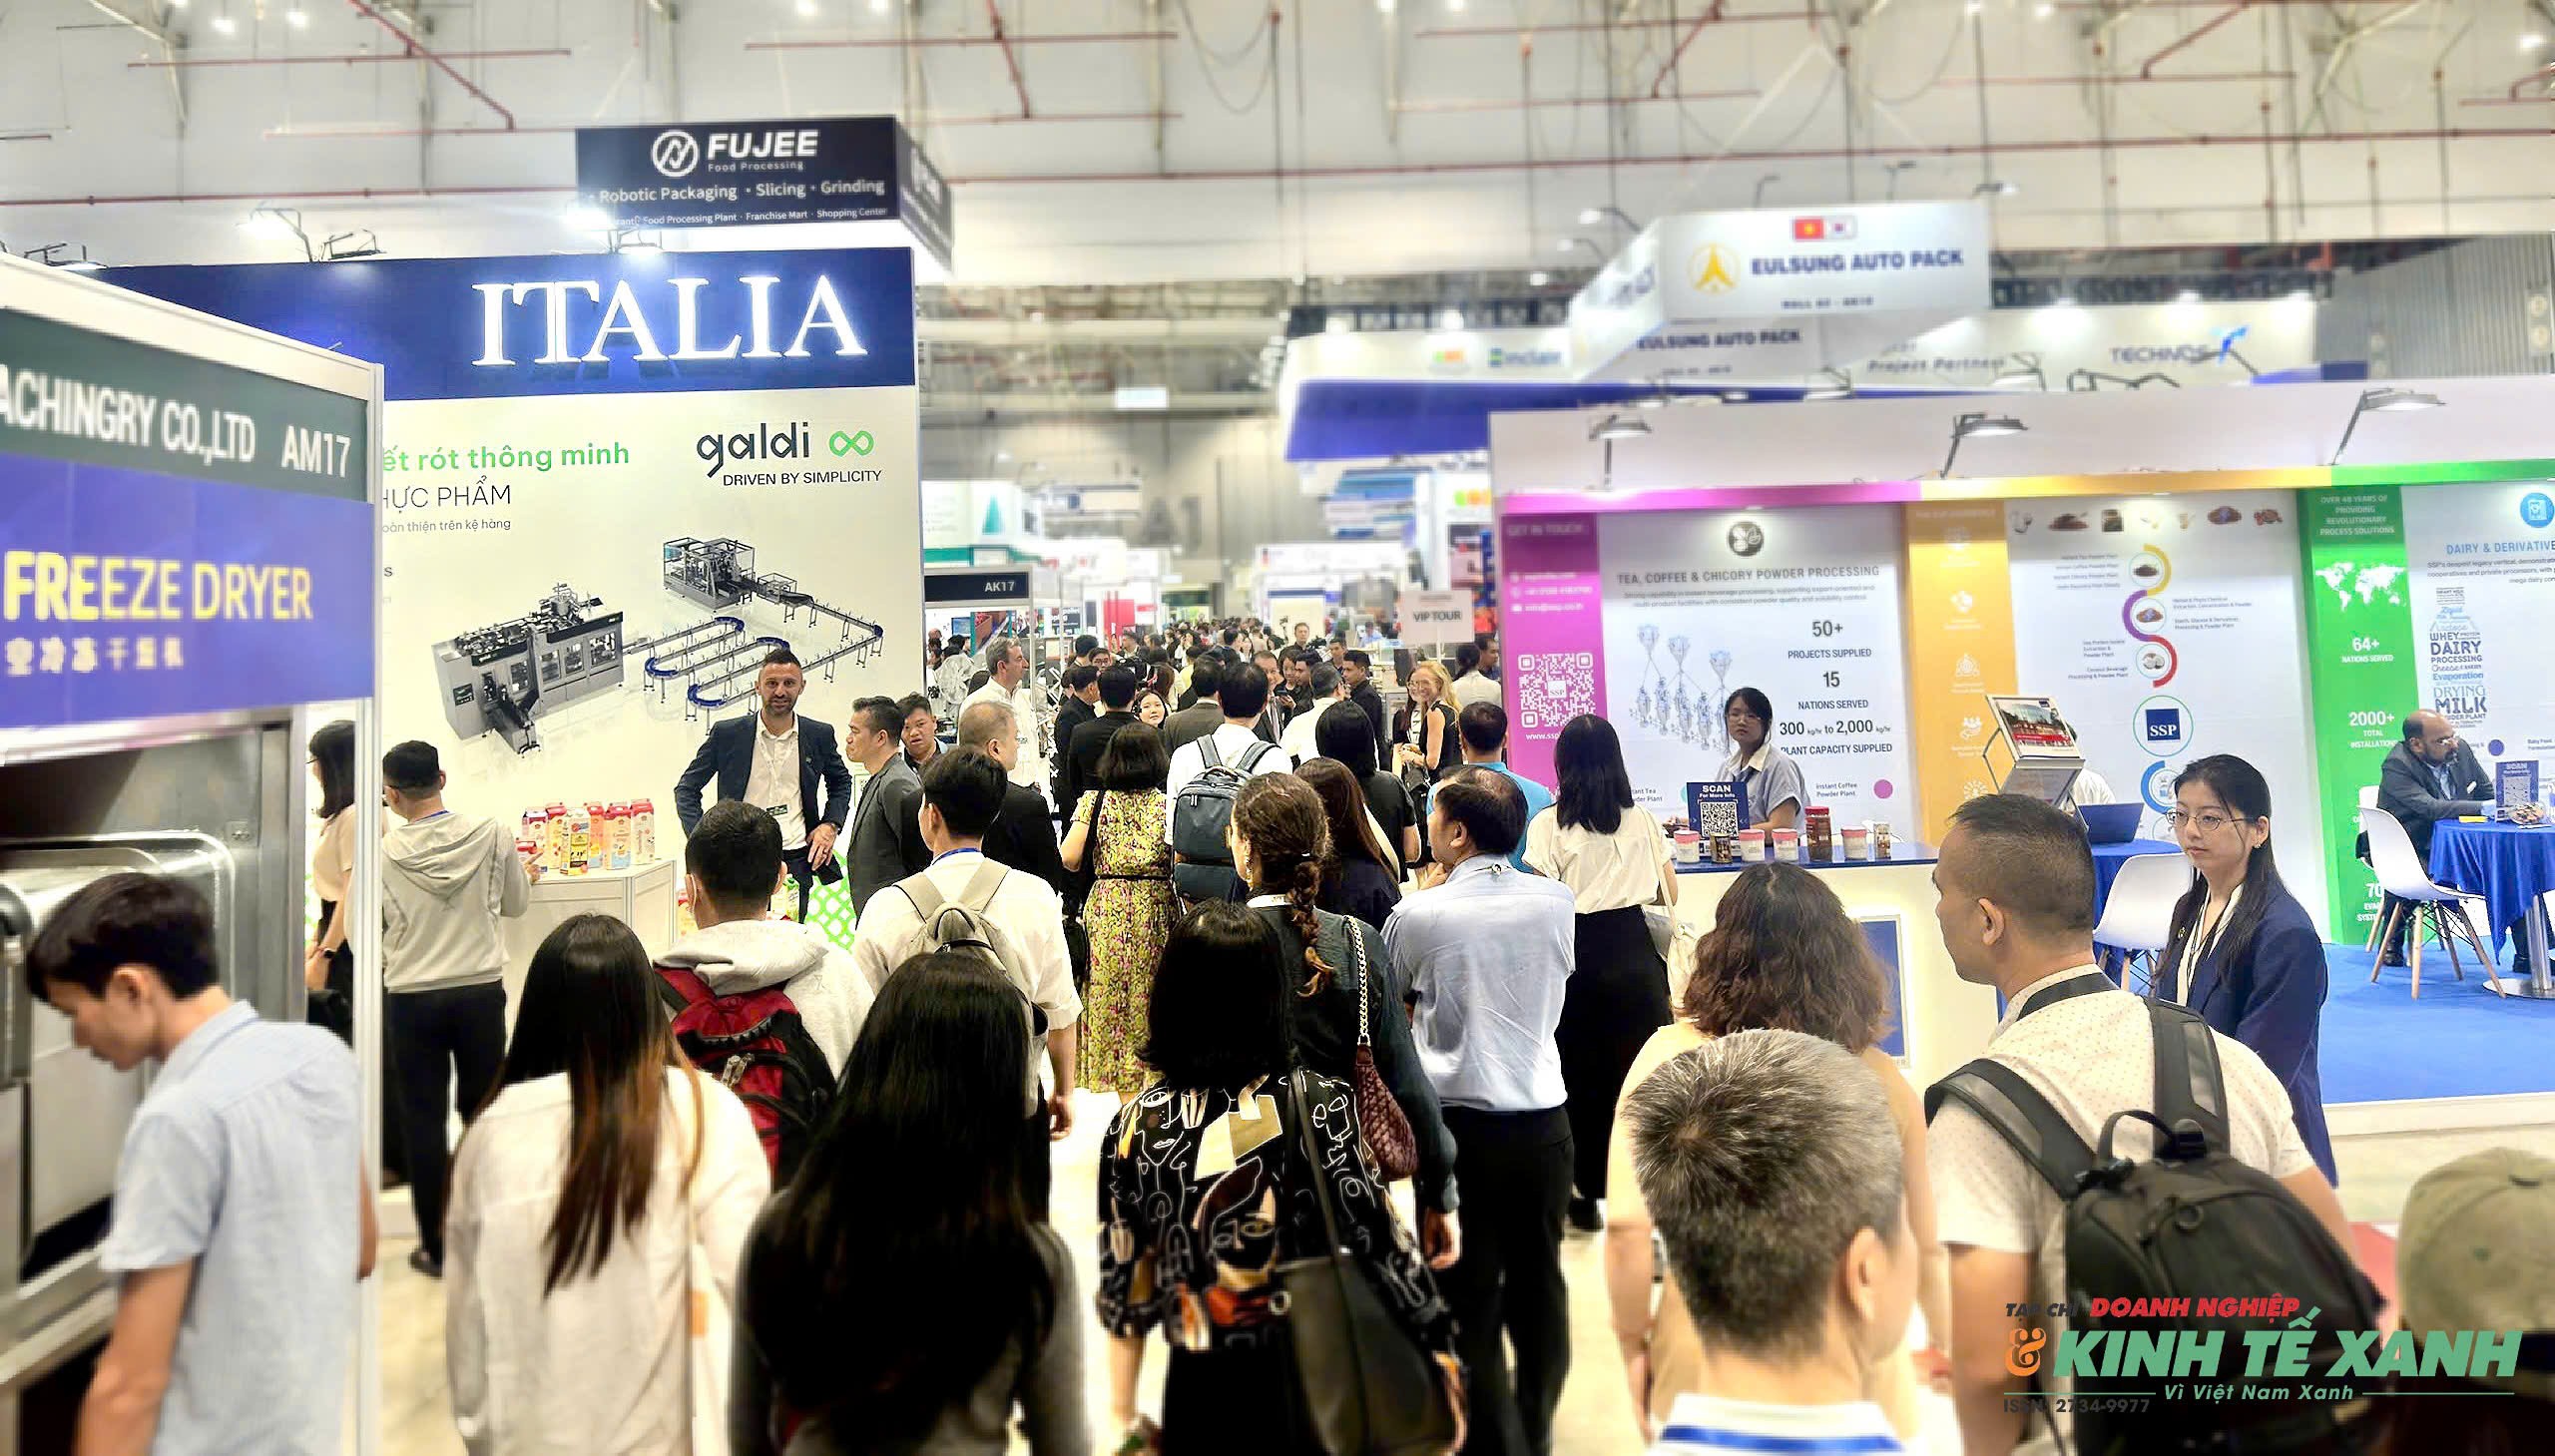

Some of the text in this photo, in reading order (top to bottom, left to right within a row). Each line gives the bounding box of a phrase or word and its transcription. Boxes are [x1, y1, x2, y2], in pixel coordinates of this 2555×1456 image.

[707, 129, 819, 161] FUJEE
[708, 160, 804, 173] Food Processing
[599, 179, 885, 203] Robotic Packaging Slicing Grinding
[667, 215, 714, 225] Processing
[715, 214, 737, 223] Plant
[746, 212, 786, 221] Franchise
[788, 210, 807, 219] Mart
[816, 209, 857, 219] Shopping
[858, 208, 887, 217] Center
[1752, 248, 1964, 274] EULSUNG AUTO PACK
[471, 274, 868, 366] ITALIA
[1715, 331, 1756, 347] AUTO
[1760, 329, 1799, 344] PACK
[280, 423, 350, 478] AM17
[418, 447, 459, 471] rót
[467, 445, 552, 471] thông
[561, 442, 630, 466] minh
[697, 422, 809, 478] galdi
[723, 469, 882, 486] DRIVEN BY SIMPLICITY
[437, 475, 511, 507] PHẨM
[407, 520, 437, 535] thiện
[439, 519, 462, 532] trên
[465, 518, 479, 533] kệ
[481, 517, 511, 531] hàng
[2325, 516, 2386, 525] REVOLUTIONARY
[2354, 526, 2395, 535] SOLUTIONS
[2446, 543, 2479, 555] DAIRY
[2482, 543, 2491, 553] &
[1618, 566, 1880, 585] TEA, COFFEE & CHICORY POWDER PROCESSING
[3, 550, 313, 621] FREEZE DRYER
[985, 582, 1015, 593] AK17
[1413, 610, 1462, 622] VIP TOUR
[1812, 620, 1843, 638] 50+
[2352, 637, 2380, 652] 64+
[2429, 632, 2460, 642] WHEY
[1788, 648, 1872, 659] PROJECTS SUPPLIED
[2430, 641, 2482, 655] DAIRY
[2370, 654, 2394, 663] SERVED
[2431, 655, 2483, 664] PROCESSING
[1822, 671, 1840, 688] 15
[2433, 672, 2484, 681] Evaporation
[2433, 686, 2486, 699] DRYING
[1797, 700, 1869, 711] NATIONS SERVED
[2435, 697, 2488, 714] MILK
[2349, 711, 2395, 727] 2000+
[1780, 722, 1804, 735] 300
[1824, 724, 1834, 733] to
[1836, 720, 1873, 735] 2,000
[2150, 725, 2178, 737] SSP
[1809, 744, 1851, 754] CAPACITY
[1853, 743, 1892, 753] SUPPLIED
